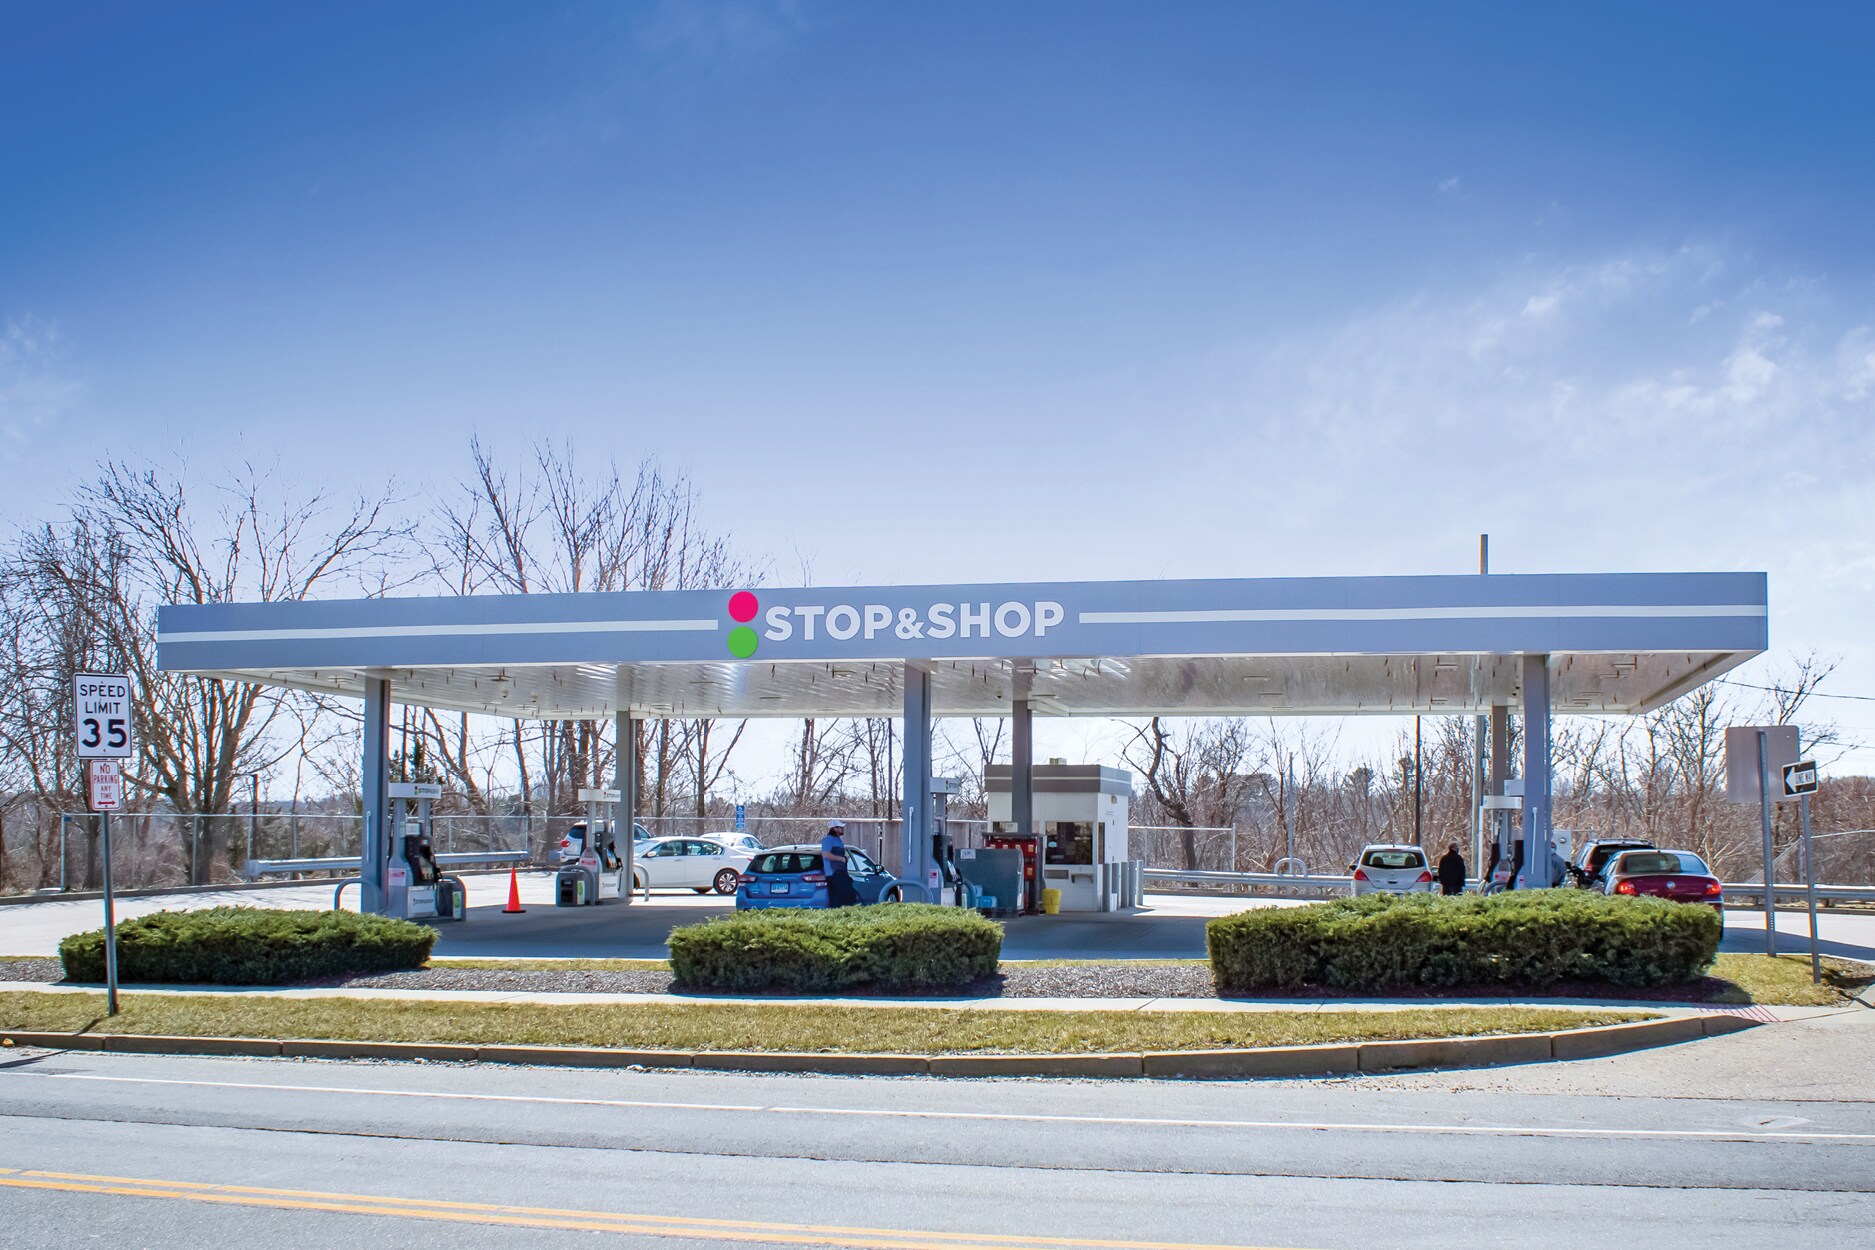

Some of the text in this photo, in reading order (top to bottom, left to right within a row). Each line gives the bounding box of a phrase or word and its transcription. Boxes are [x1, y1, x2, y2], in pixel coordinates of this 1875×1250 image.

[764, 601, 1065, 641] STOP&SHOP
[80, 684, 126, 698] SPEED
[85, 702, 121, 714] LIMIT
[81, 718, 128, 748] 35
[99, 764, 111, 774] NO
[93, 774, 118, 784] PARKING
[100, 792, 113, 800] TIME
